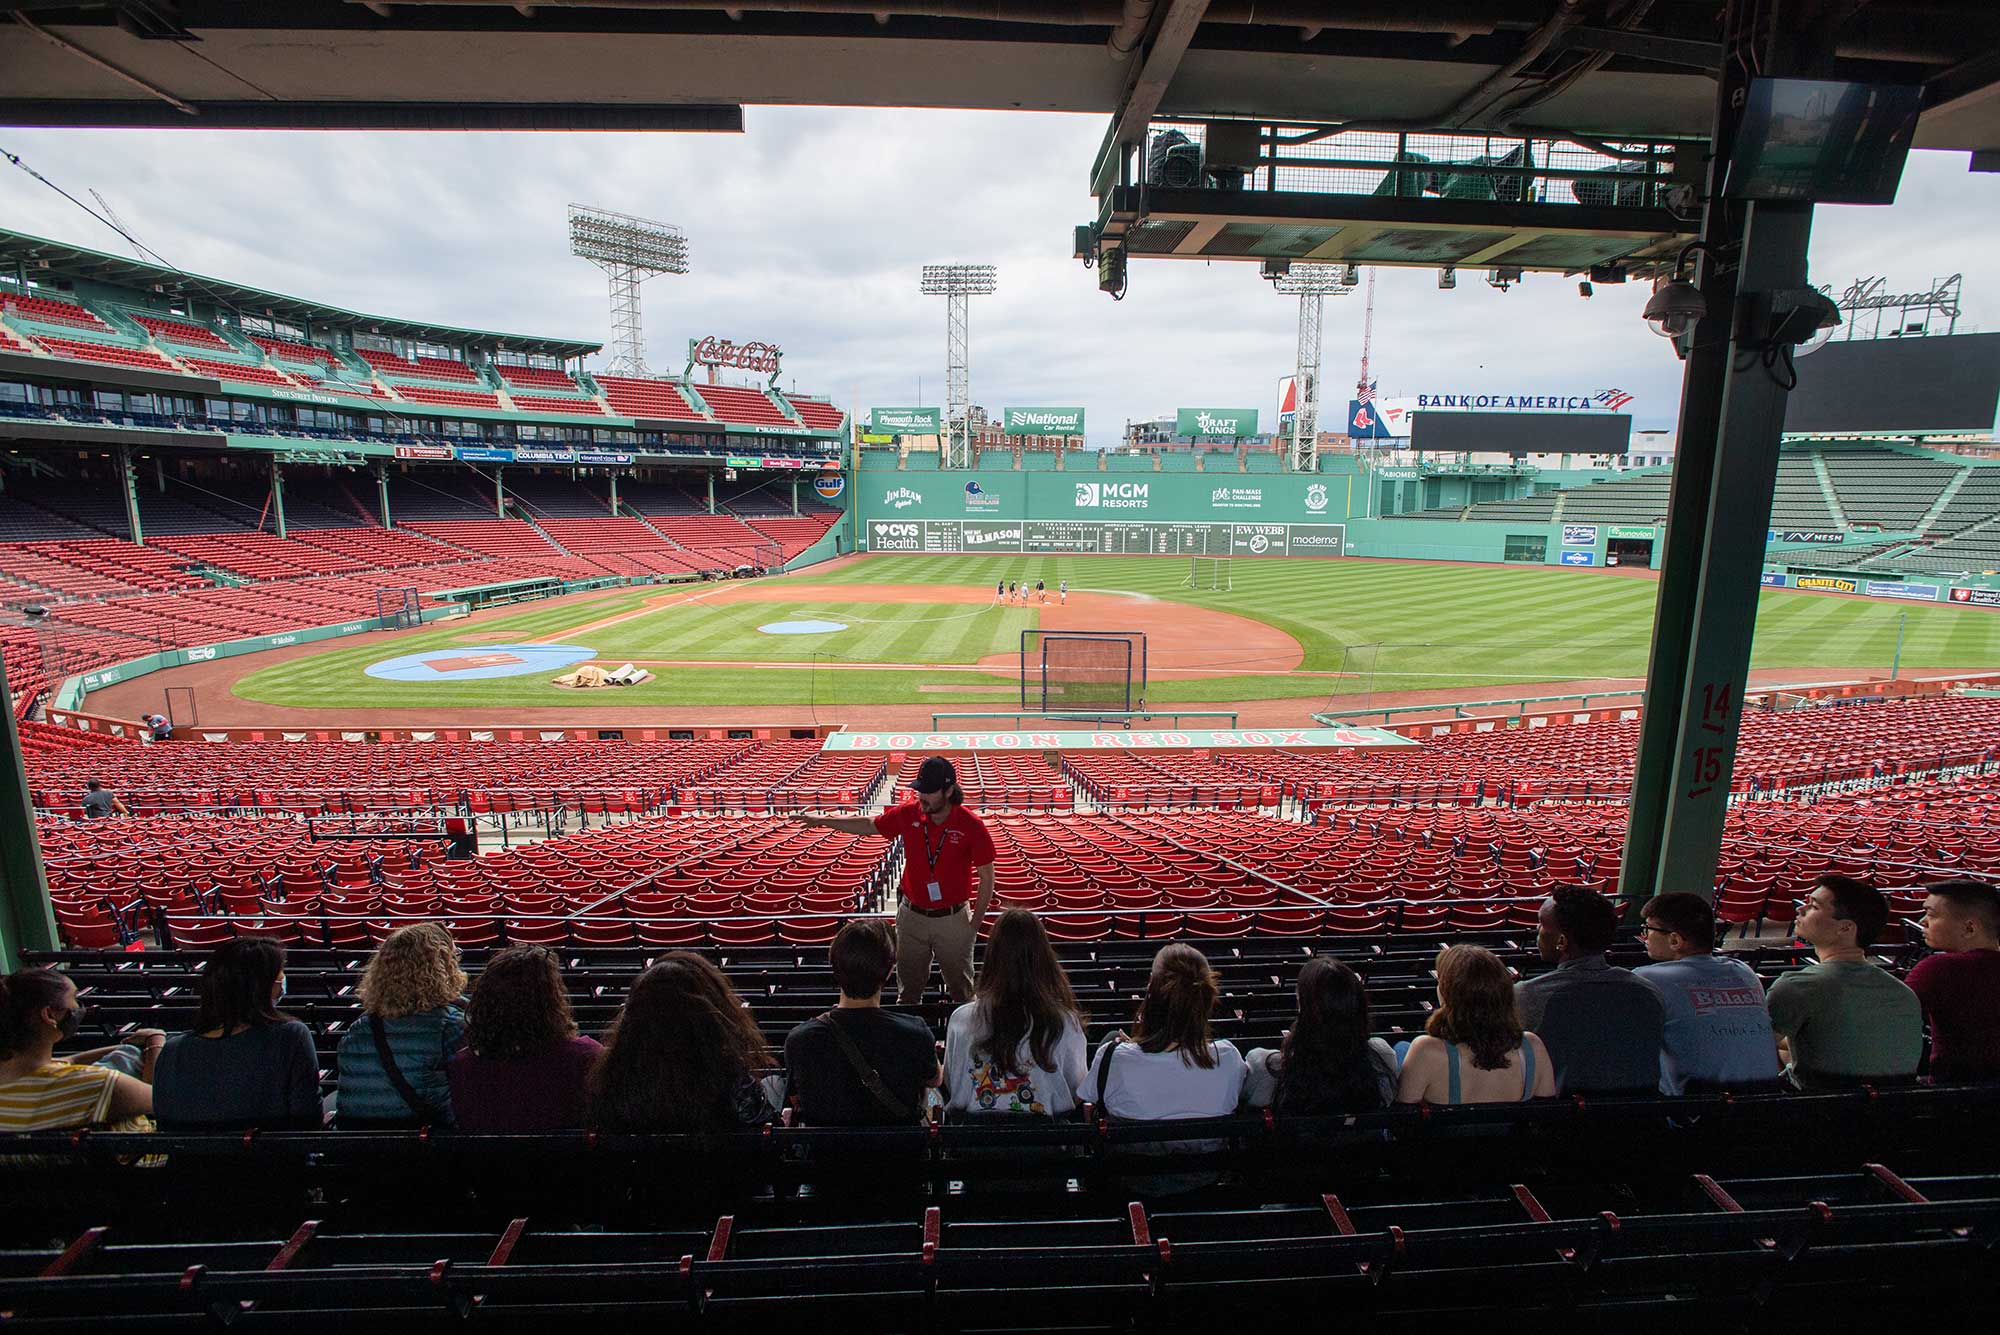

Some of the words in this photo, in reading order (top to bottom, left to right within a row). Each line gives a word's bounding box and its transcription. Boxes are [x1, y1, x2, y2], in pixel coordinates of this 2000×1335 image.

[1838, 273, 1961, 317] Hancock
[694, 335, 780, 373] Coca-Cola
[272, 389, 289, 398] STATE
[290, 391, 311, 400] STREET
[312, 393, 338, 404] PAVILION
[1418, 394, 1470, 407] BANK
[1476, 395, 1500, 408] OF
[1505, 395, 1591, 409] AMERICA
[880, 415, 912, 424] Plymouth
[914, 415, 932, 423] Rock
[1026, 413, 1078, 424] National
[1201, 419, 1238, 427] DRAFT
[555, 452, 572, 460] TECH
[815, 479, 842, 488] Gulf
[884, 490, 899, 504] JIM
[900, 487, 922, 504] BEAM
[1103, 483, 1149, 498] MGM
[1102, 499, 1148, 508] RESORTS
[888, 524, 919, 536] CVS
[1255, 526, 1284, 535] WEBB
[876, 537, 919, 549] Health
[1292, 535, 1338, 544] moderna
[1798, 578, 1834, 587] GRANITE
[1835, 579, 1856, 592] CITY
[84, 675, 99, 685] DELL
[1704, 683, 1732, 720] 14
[850, 733, 1061, 750] BOSTON
[1094, 733, 1192, 748] RED
[1211, 731, 1307, 746] SOX
[1693, 747, 1723, 783] 15
